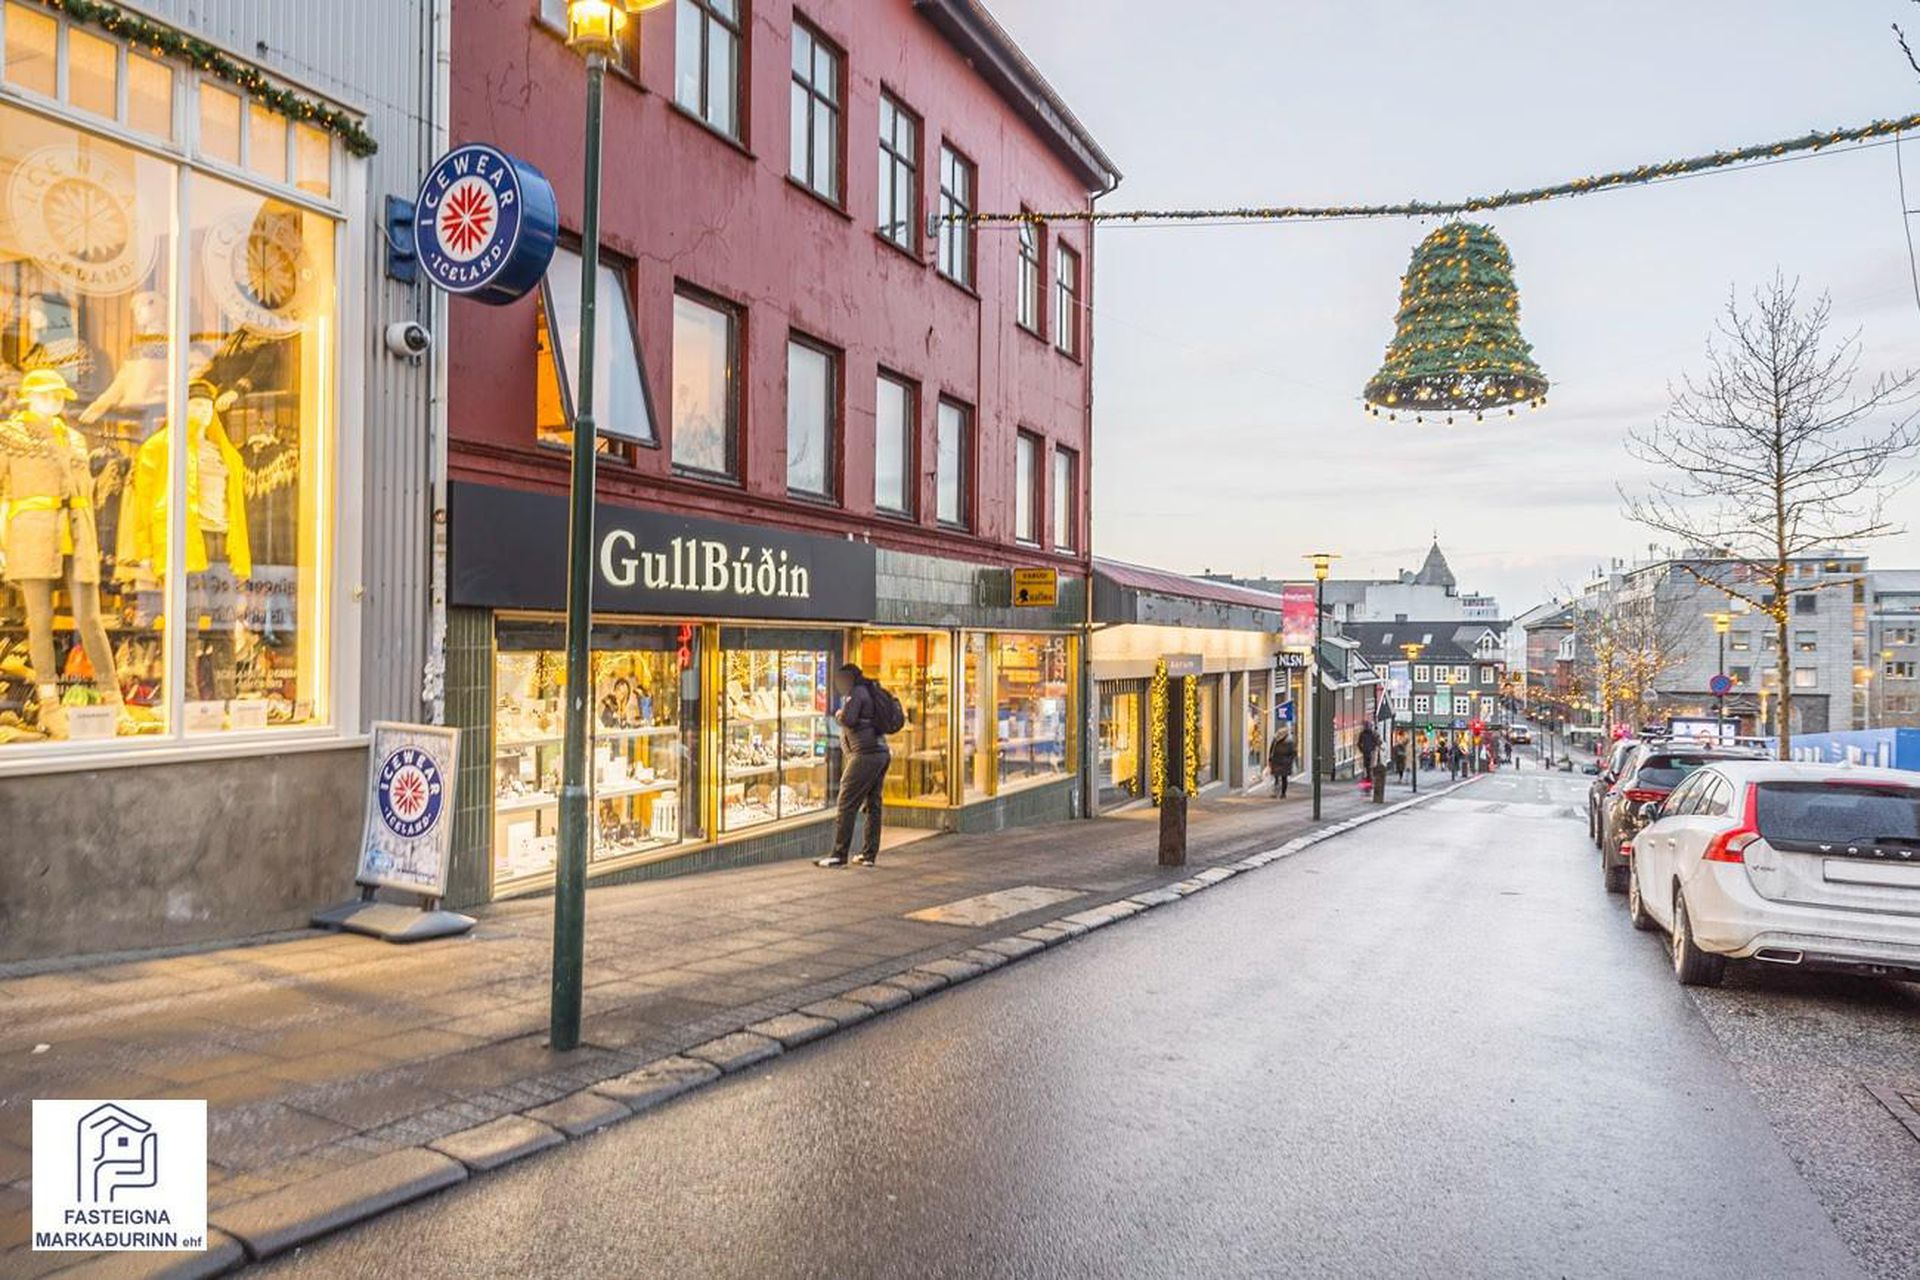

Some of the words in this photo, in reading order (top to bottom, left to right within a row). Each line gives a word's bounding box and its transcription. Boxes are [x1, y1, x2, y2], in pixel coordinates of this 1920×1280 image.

[420, 153, 515, 226] ICEWEAR
[431, 244, 503, 282] ICELAND
[600, 528, 810, 598] GullBúðin
[380, 749, 441, 796] ICEWEAR
